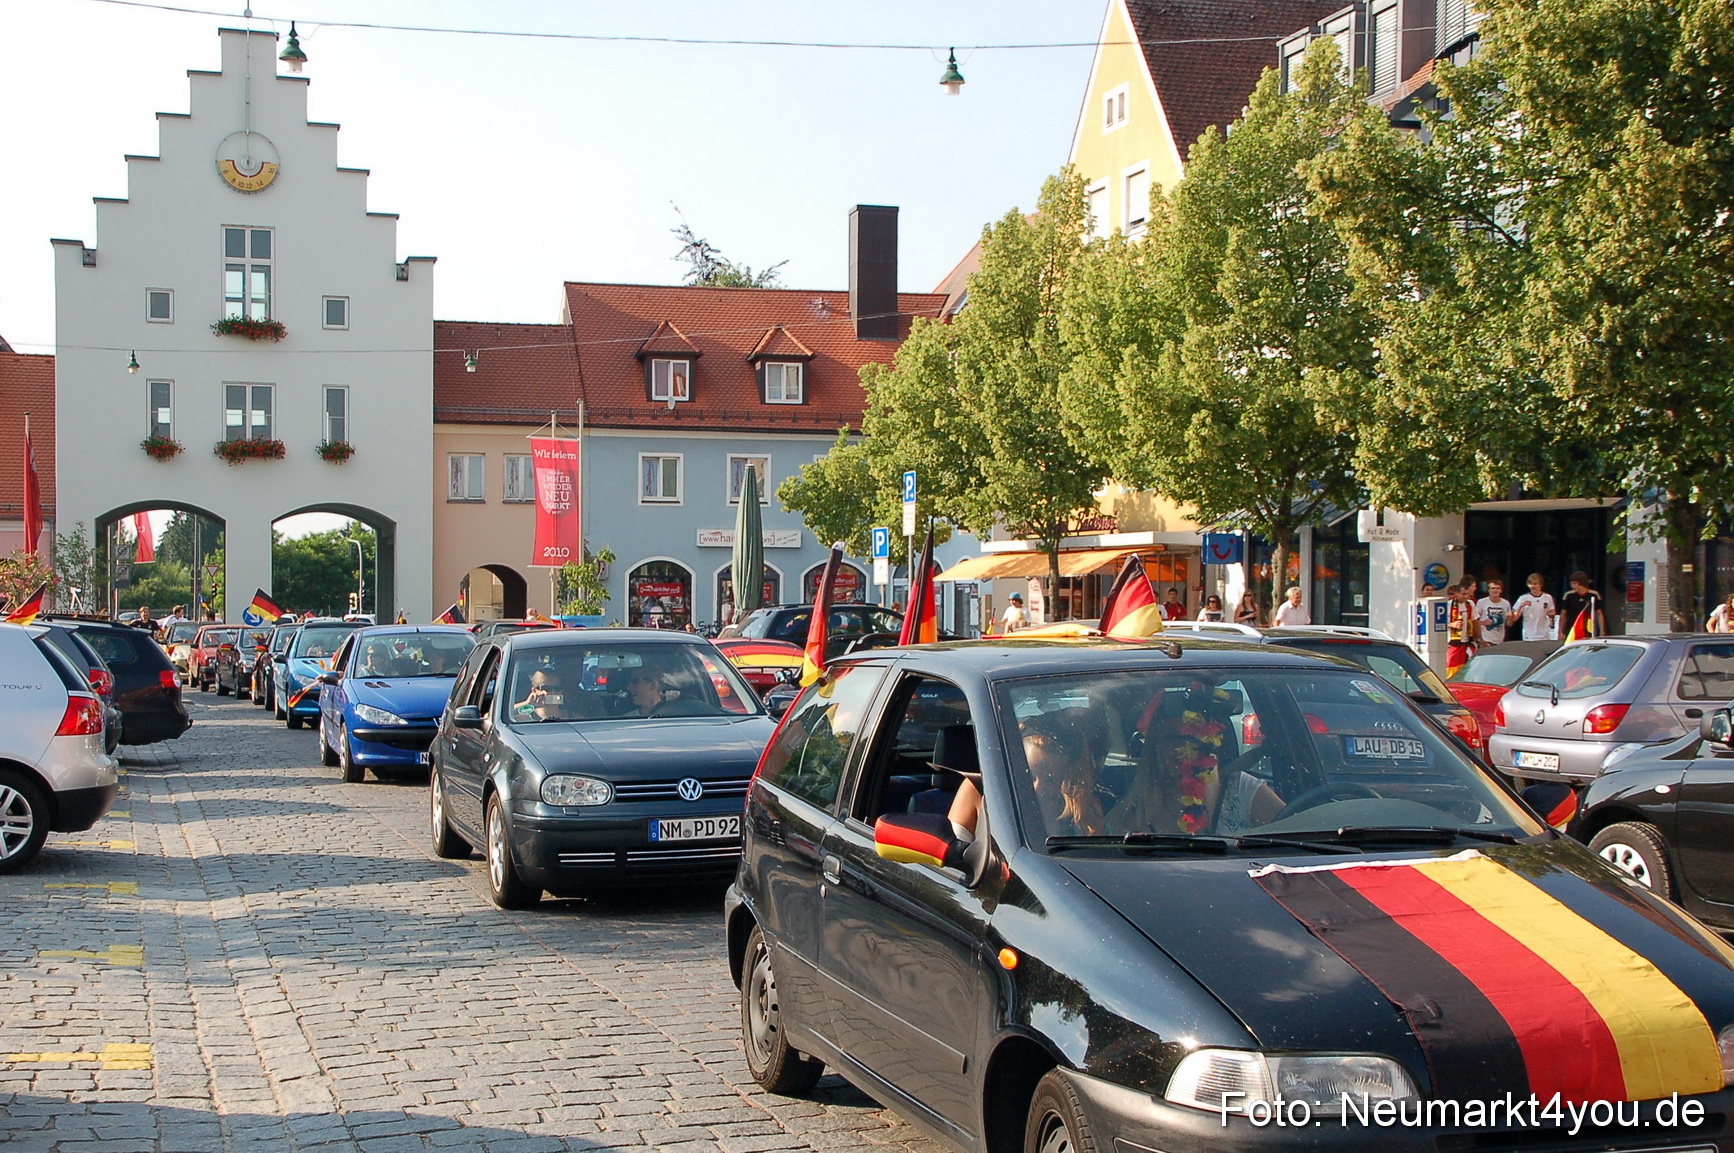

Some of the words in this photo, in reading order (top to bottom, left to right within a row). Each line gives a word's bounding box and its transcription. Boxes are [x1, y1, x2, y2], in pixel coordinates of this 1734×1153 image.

[534, 449, 550, 458] Wir
[551, 449, 577, 460] feiern
[906, 475, 914, 500] P
[545, 491, 570, 501] NEU
[875, 531, 885, 555] P
[543, 546, 570, 557] 2010
[1437, 606, 1446, 620] P
[1354, 738, 1380, 754] LAU
[1390, 740, 1406, 756] DB
[1408, 741, 1423, 756] 15
[660, 821, 682, 839] NM
[694, 820, 715, 837] PD
[718, 818, 739, 835] 92
